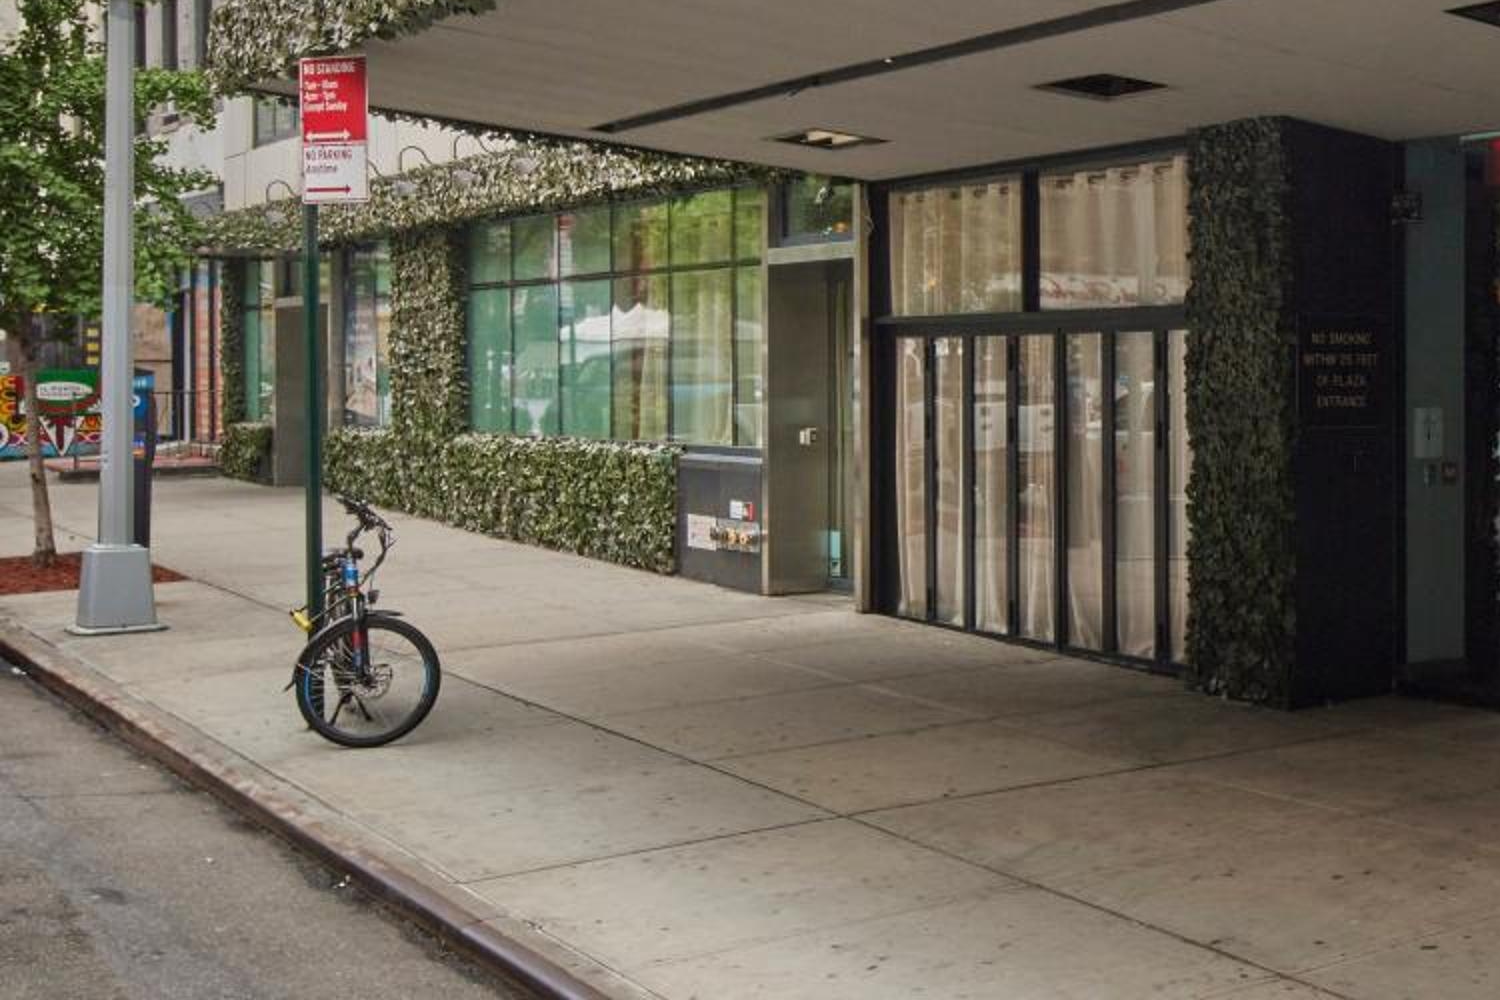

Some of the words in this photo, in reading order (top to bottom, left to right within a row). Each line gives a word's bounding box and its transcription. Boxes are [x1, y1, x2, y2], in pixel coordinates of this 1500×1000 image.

[303, 63, 315, 75] NO
[317, 62, 355, 74] STANDING
[306, 150, 316, 161] NO
[318, 149, 352, 160] PARKING
